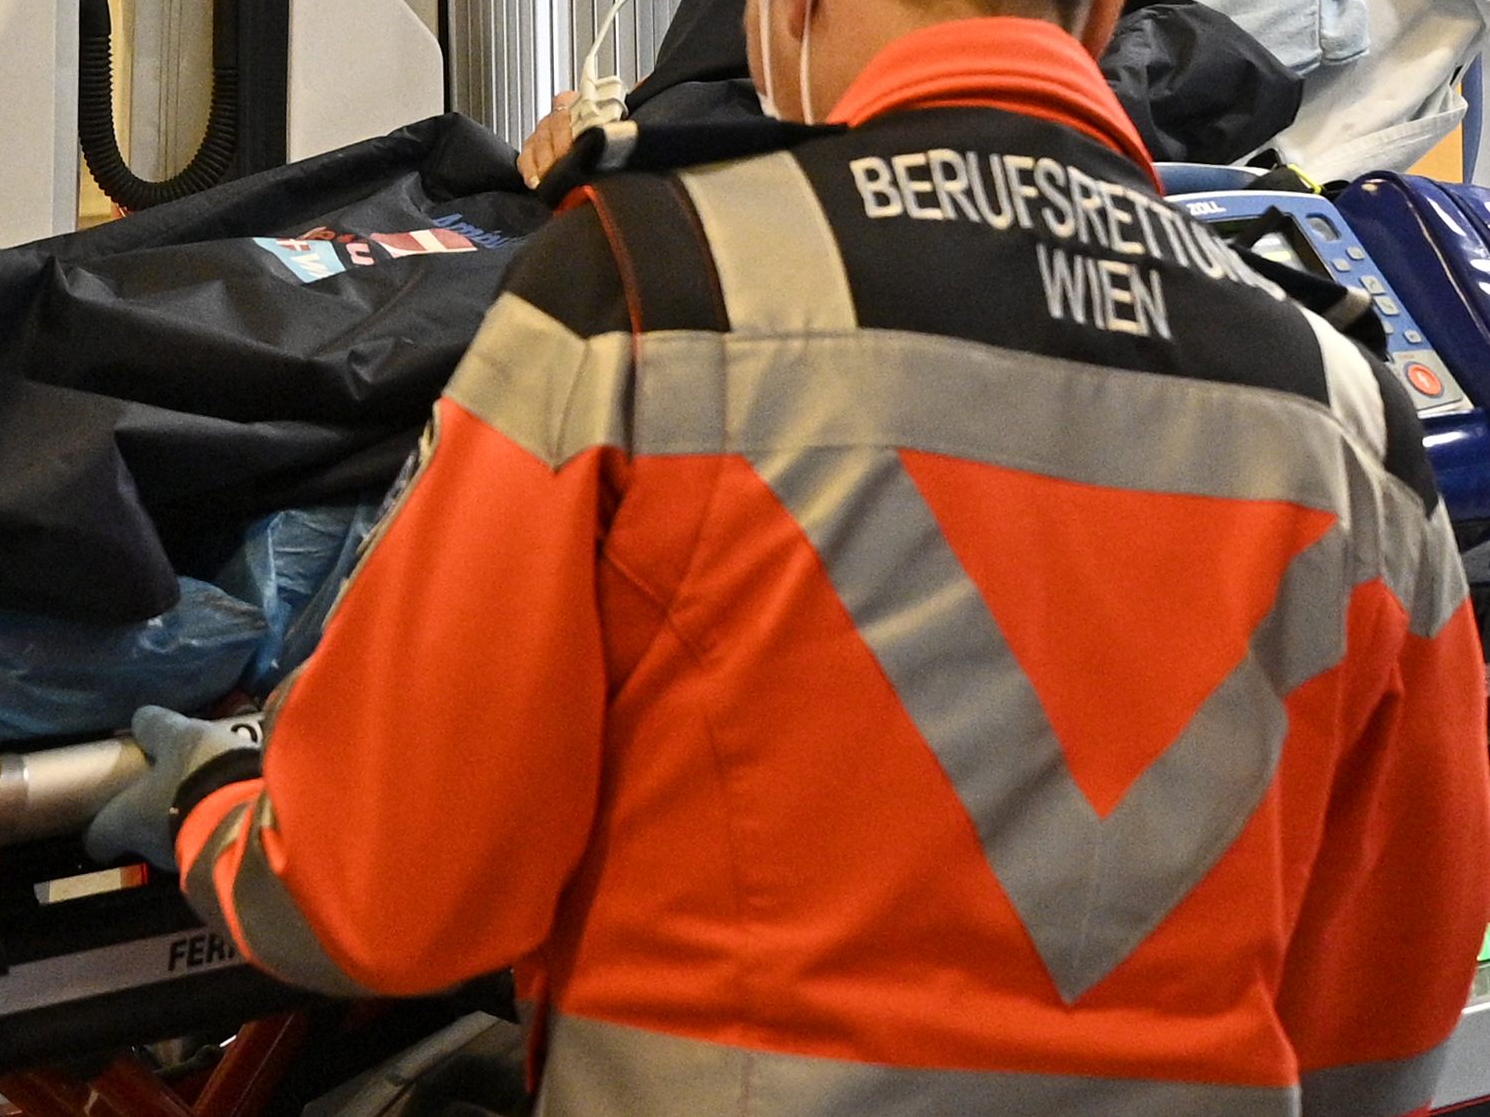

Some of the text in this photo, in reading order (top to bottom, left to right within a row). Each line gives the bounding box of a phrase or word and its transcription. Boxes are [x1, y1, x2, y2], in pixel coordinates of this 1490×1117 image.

[1186, 201, 1227, 216] ZOLL
[1036, 243, 1173, 340] WIEN
[168, 932, 235, 972] FER
